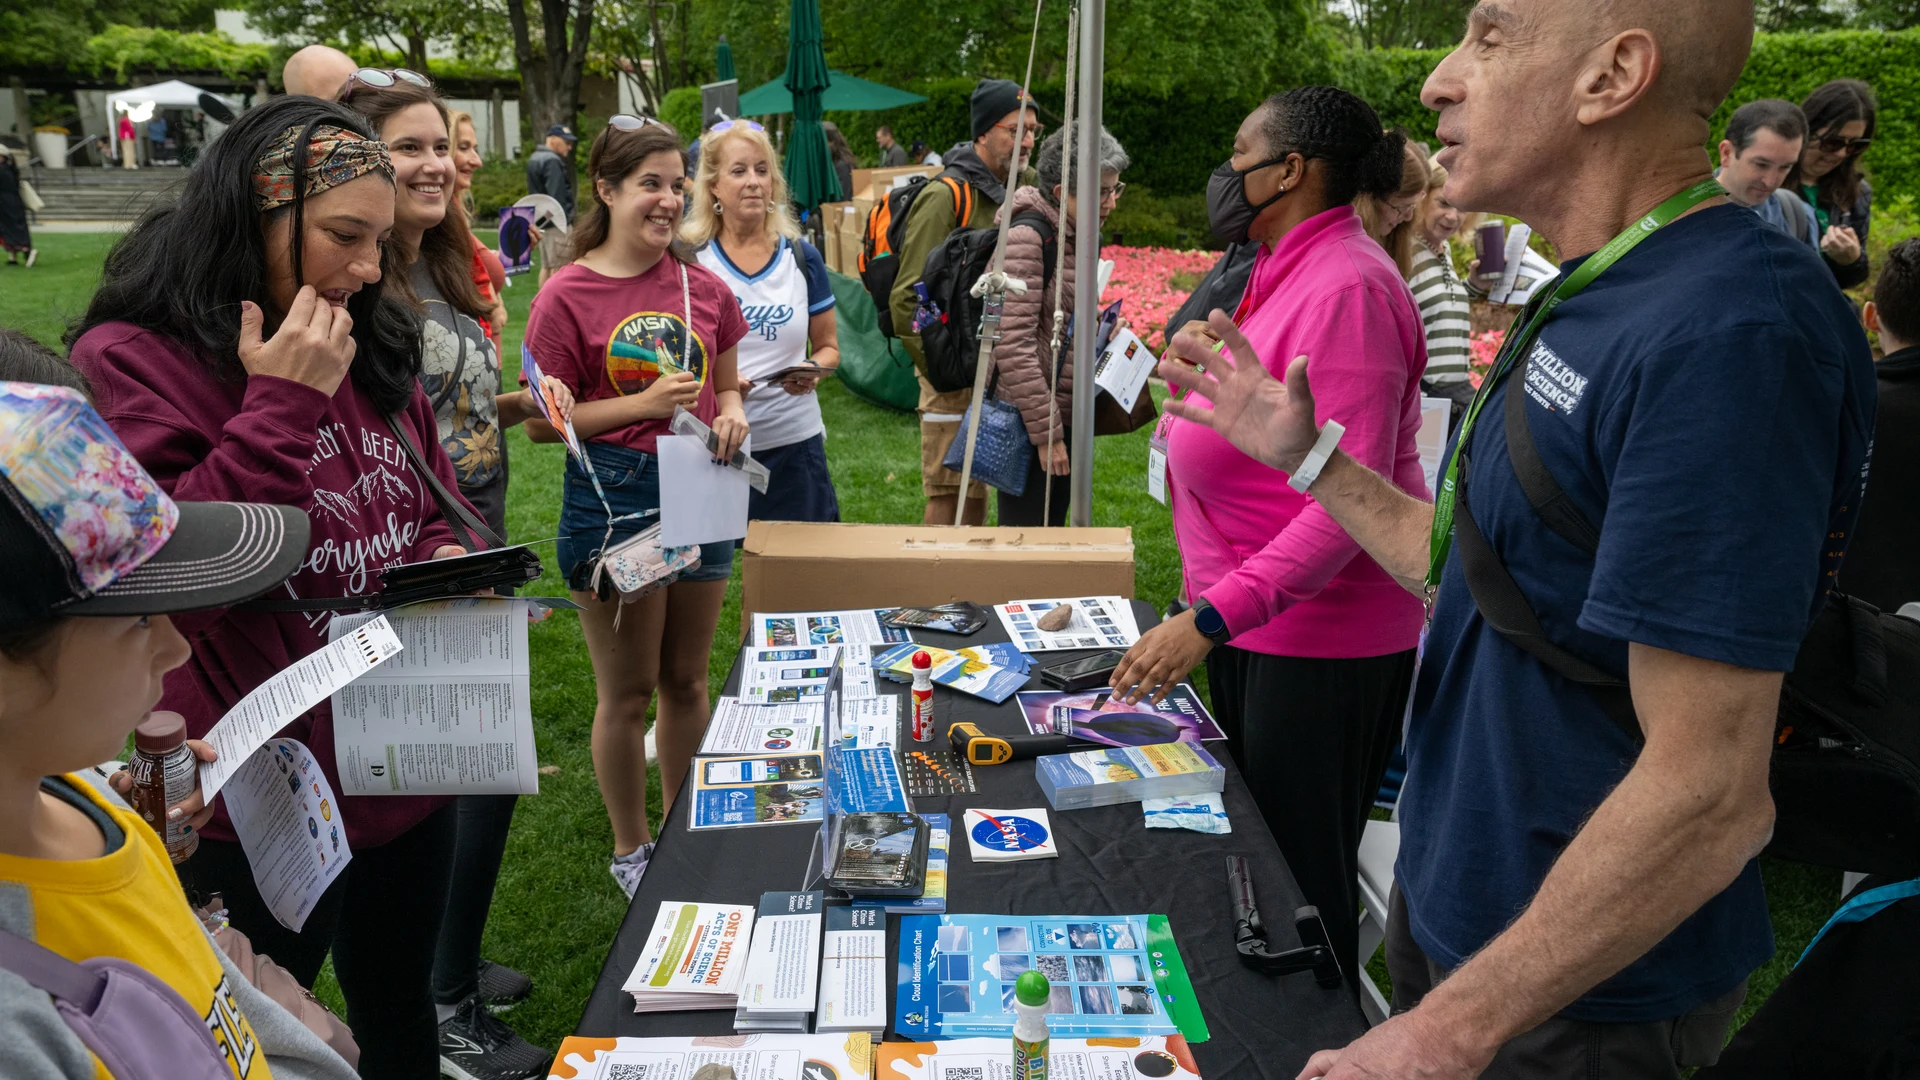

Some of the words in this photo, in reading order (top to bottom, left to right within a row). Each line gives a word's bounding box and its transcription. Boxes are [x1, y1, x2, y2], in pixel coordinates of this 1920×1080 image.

[623, 317, 675, 341] NASA
[759, 320, 777, 341] TB
[1530, 345, 1587, 396] MILLION
[1529, 370, 1576, 410] SCIENCE
[305, 422, 355, 475] VEN'T
[361, 426, 407, 471] BEEN
[1173, 697, 1203, 724] ATION
[165, 767, 185, 778] Calories
[1000, 818, 1020, 849] NASA
[788, 895, 797, 913] Science?
[797, 894, 805, 909] Citizen
[805, 894, 814, 906] What
[711, 912, 727, 936] ACTS
[852, 909, 860, 928] Science?
[859, 909, 868, 925] Citizen
[868, 909, 876, 923] What
[723, 912, 742, 938] ONE
[700, 925, 711, 943] CITIZEN
[914, 929, 923, 945] Chart
[1037, 924, 1046, 949] CONVECTIVE
[1045, 928, 1053, 945] CLOUDS
[693, 943, 706, 960] SCIENCE
[707, 938, 718, 950] OF
[686, 959, 698, 975] MONTH
[691, 952, 714, 984] SCIENCE
[705, 941, 733, 986] MILLION
[912, 945, 923, 983] Identification
[911, 983, 922, 1002] Cloud
[663, 1058, 672, 1071] Learn
[744, 1052, 752, 1065] What
[770, 1054, 779, 1068] Share
[1060, 1054, 1068, 1062] the
[1075, 1054, 1084, 1067] What
[1101, 1055, 1111, 1070] Share
[671, 1064, 679, 1073] Get
[1004, 1065, 1012, 1075] Get
[1061, 1062, 1070, 1077] eclipse
